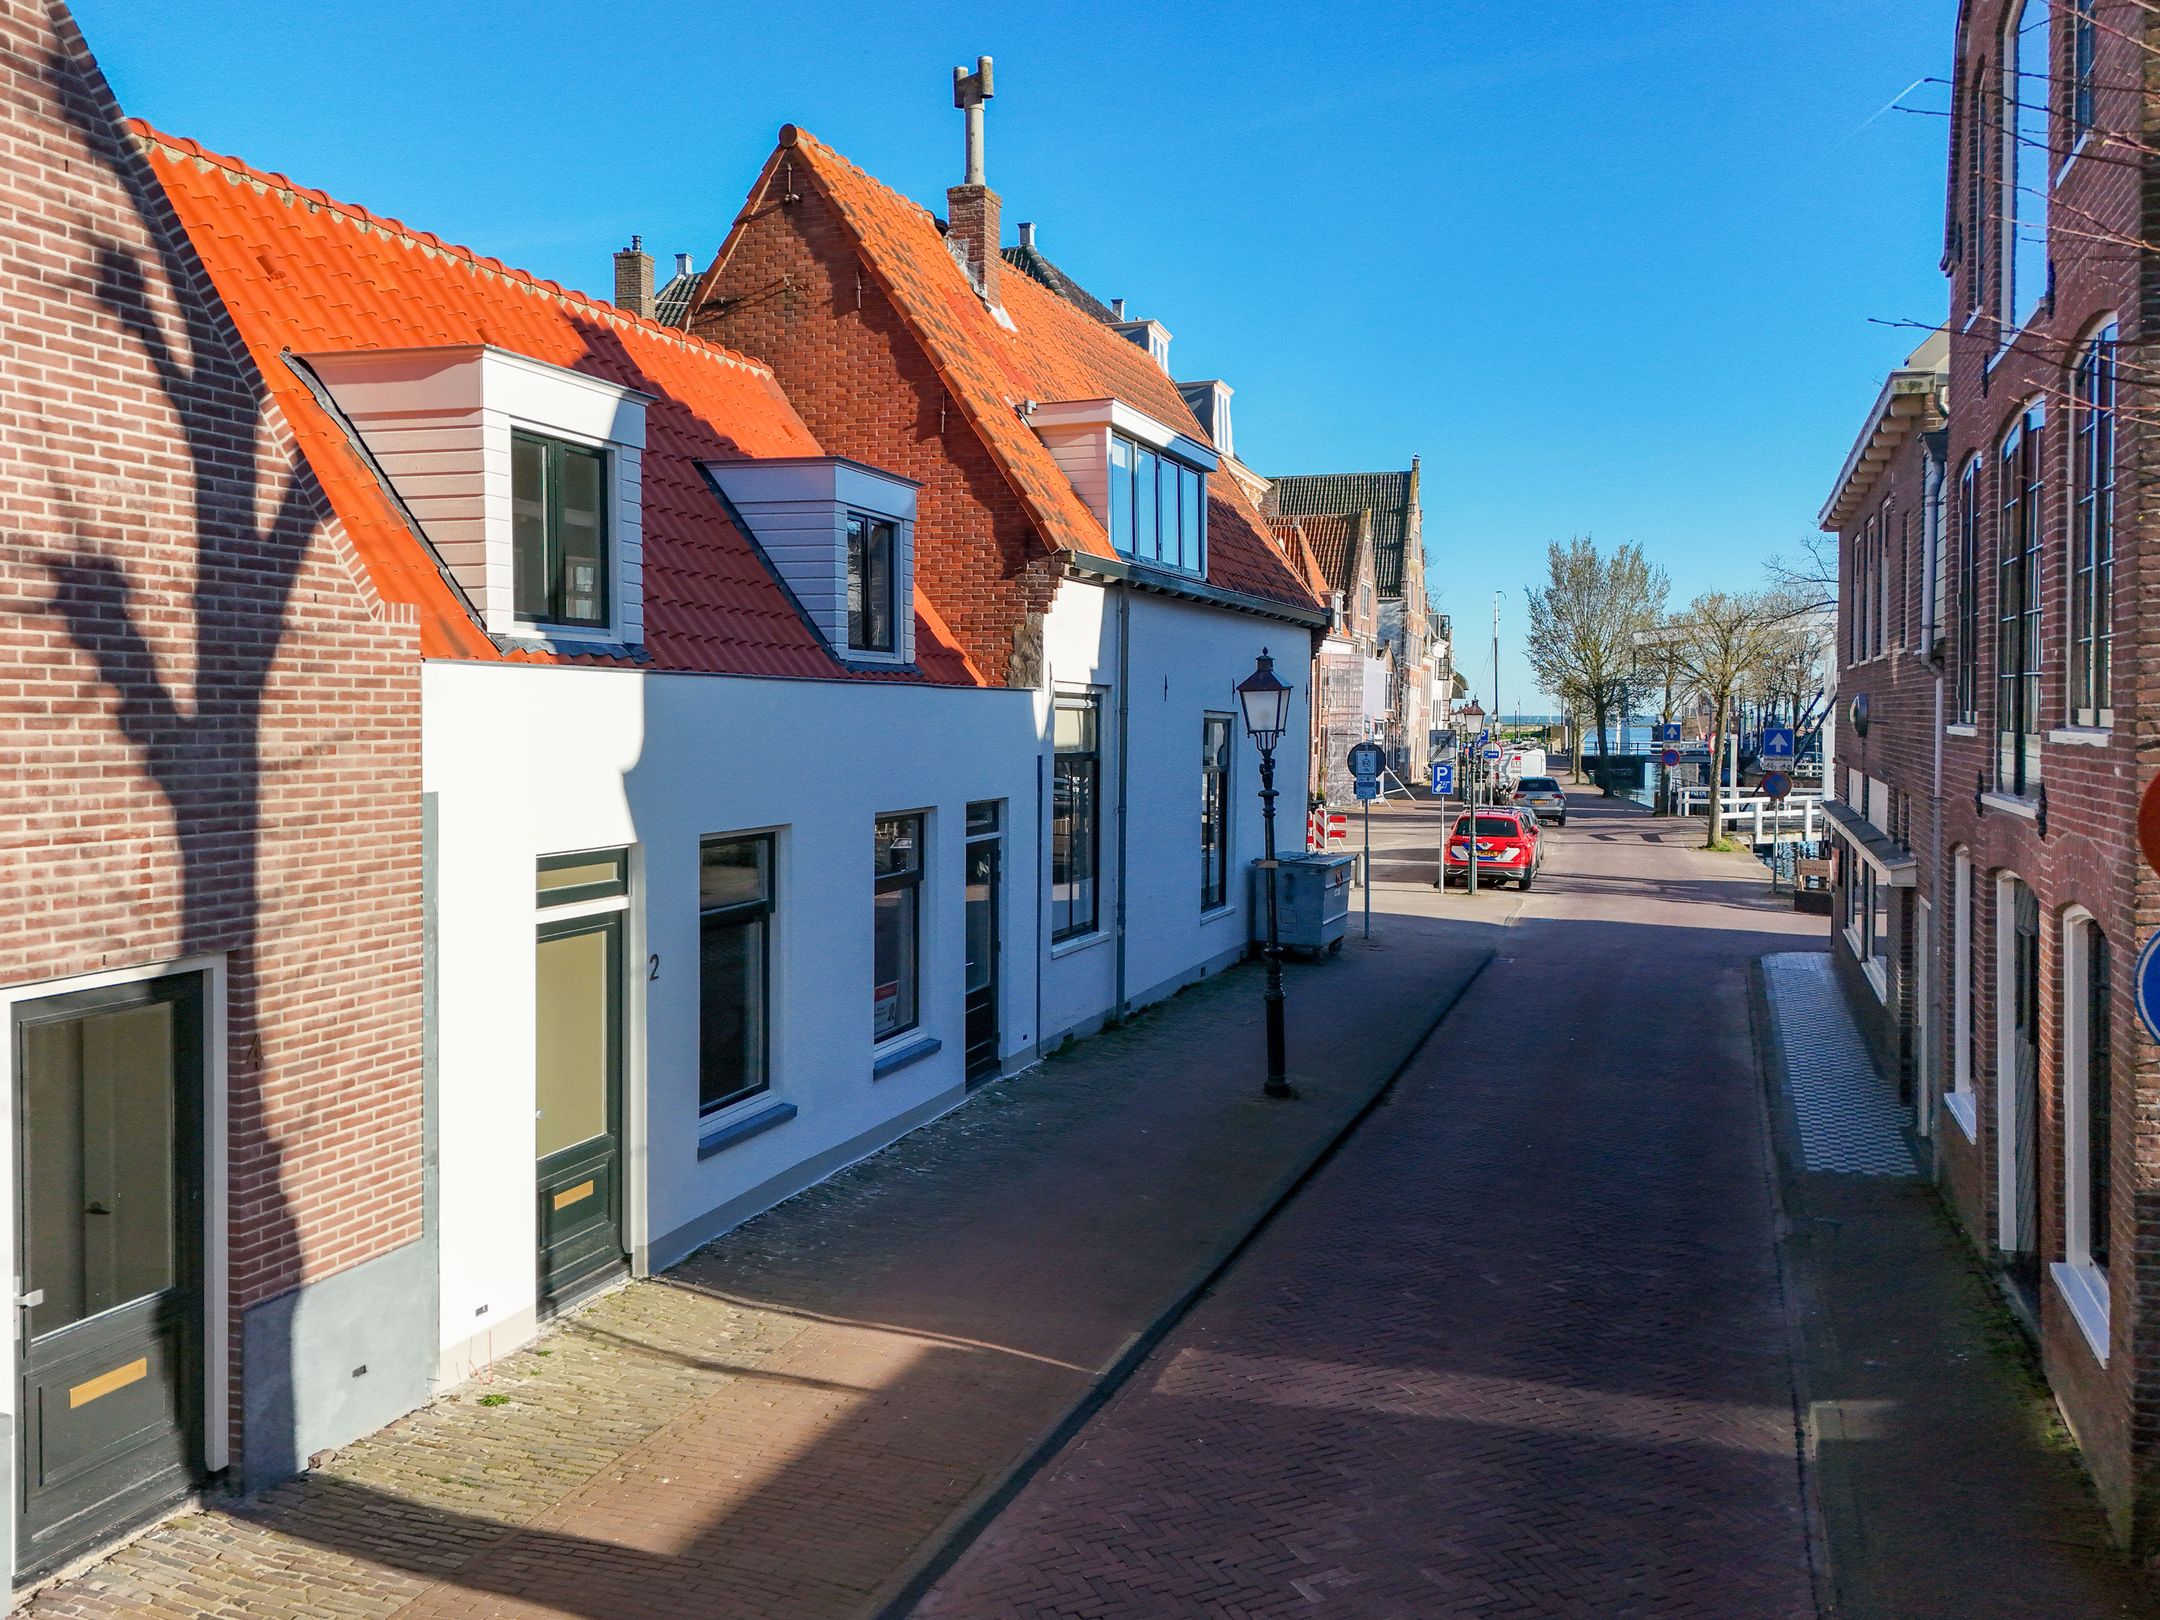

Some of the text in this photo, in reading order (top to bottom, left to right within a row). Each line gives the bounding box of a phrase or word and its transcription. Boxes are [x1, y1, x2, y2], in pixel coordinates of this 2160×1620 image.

[1437, 766, 1448, 781] P
[649, 953, 659, 981] 2
[246, 1032, 263, 1071] 4
